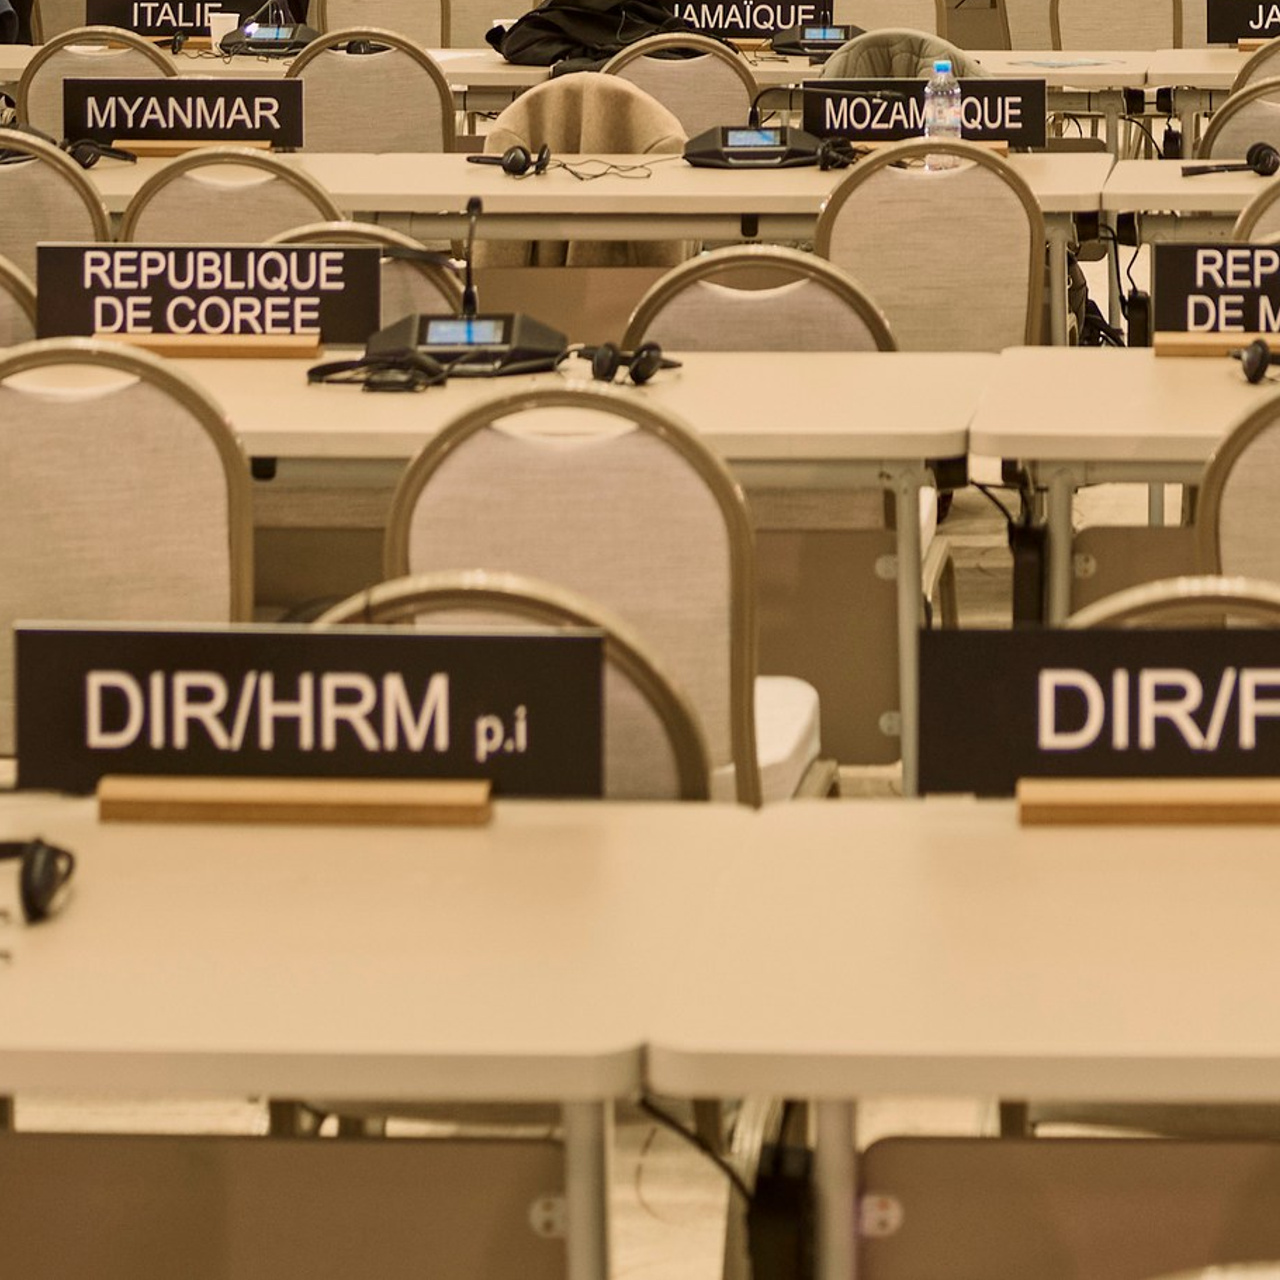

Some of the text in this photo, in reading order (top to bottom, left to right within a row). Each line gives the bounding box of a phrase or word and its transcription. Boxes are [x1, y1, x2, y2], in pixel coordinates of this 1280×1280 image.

[132, 1, 223, 27] ITALIE
[86, 96, 281, 129] MYANMAR
[825, 96, 1023, 130] MOZAMQUE
[83, 250, 345, 290] REPUBLIQUE
[94, 296, 321, 335] DE COREE
[1187, 295, 1246, 333] DE
[85, 668, 529, 763] DIR/HRM p.i
